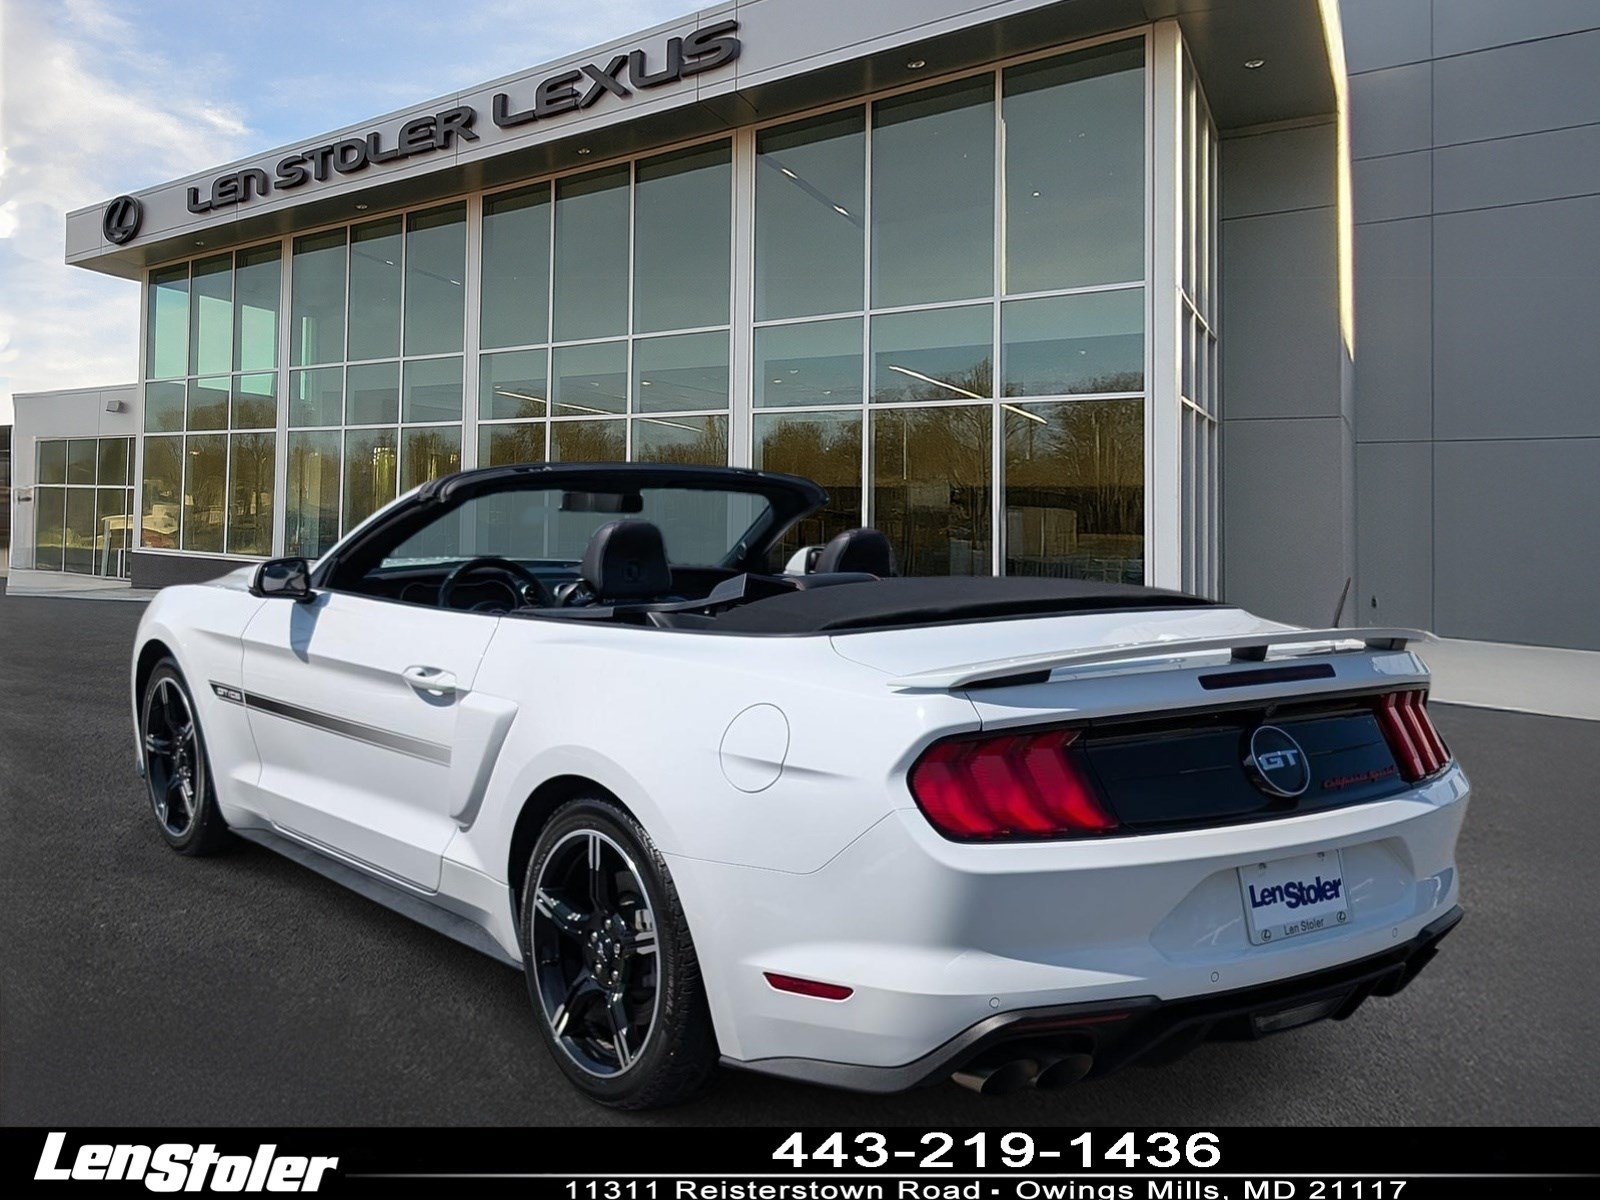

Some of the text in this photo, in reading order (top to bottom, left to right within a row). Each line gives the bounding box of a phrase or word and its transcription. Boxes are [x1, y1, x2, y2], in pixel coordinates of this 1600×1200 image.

[274, 105, 478, 189] STOLER
[493, 19, 740, 127] LEXUS
[1259, 750, 1298, 771] GT
[1284, 918, 1324, 936] Len Stoler
